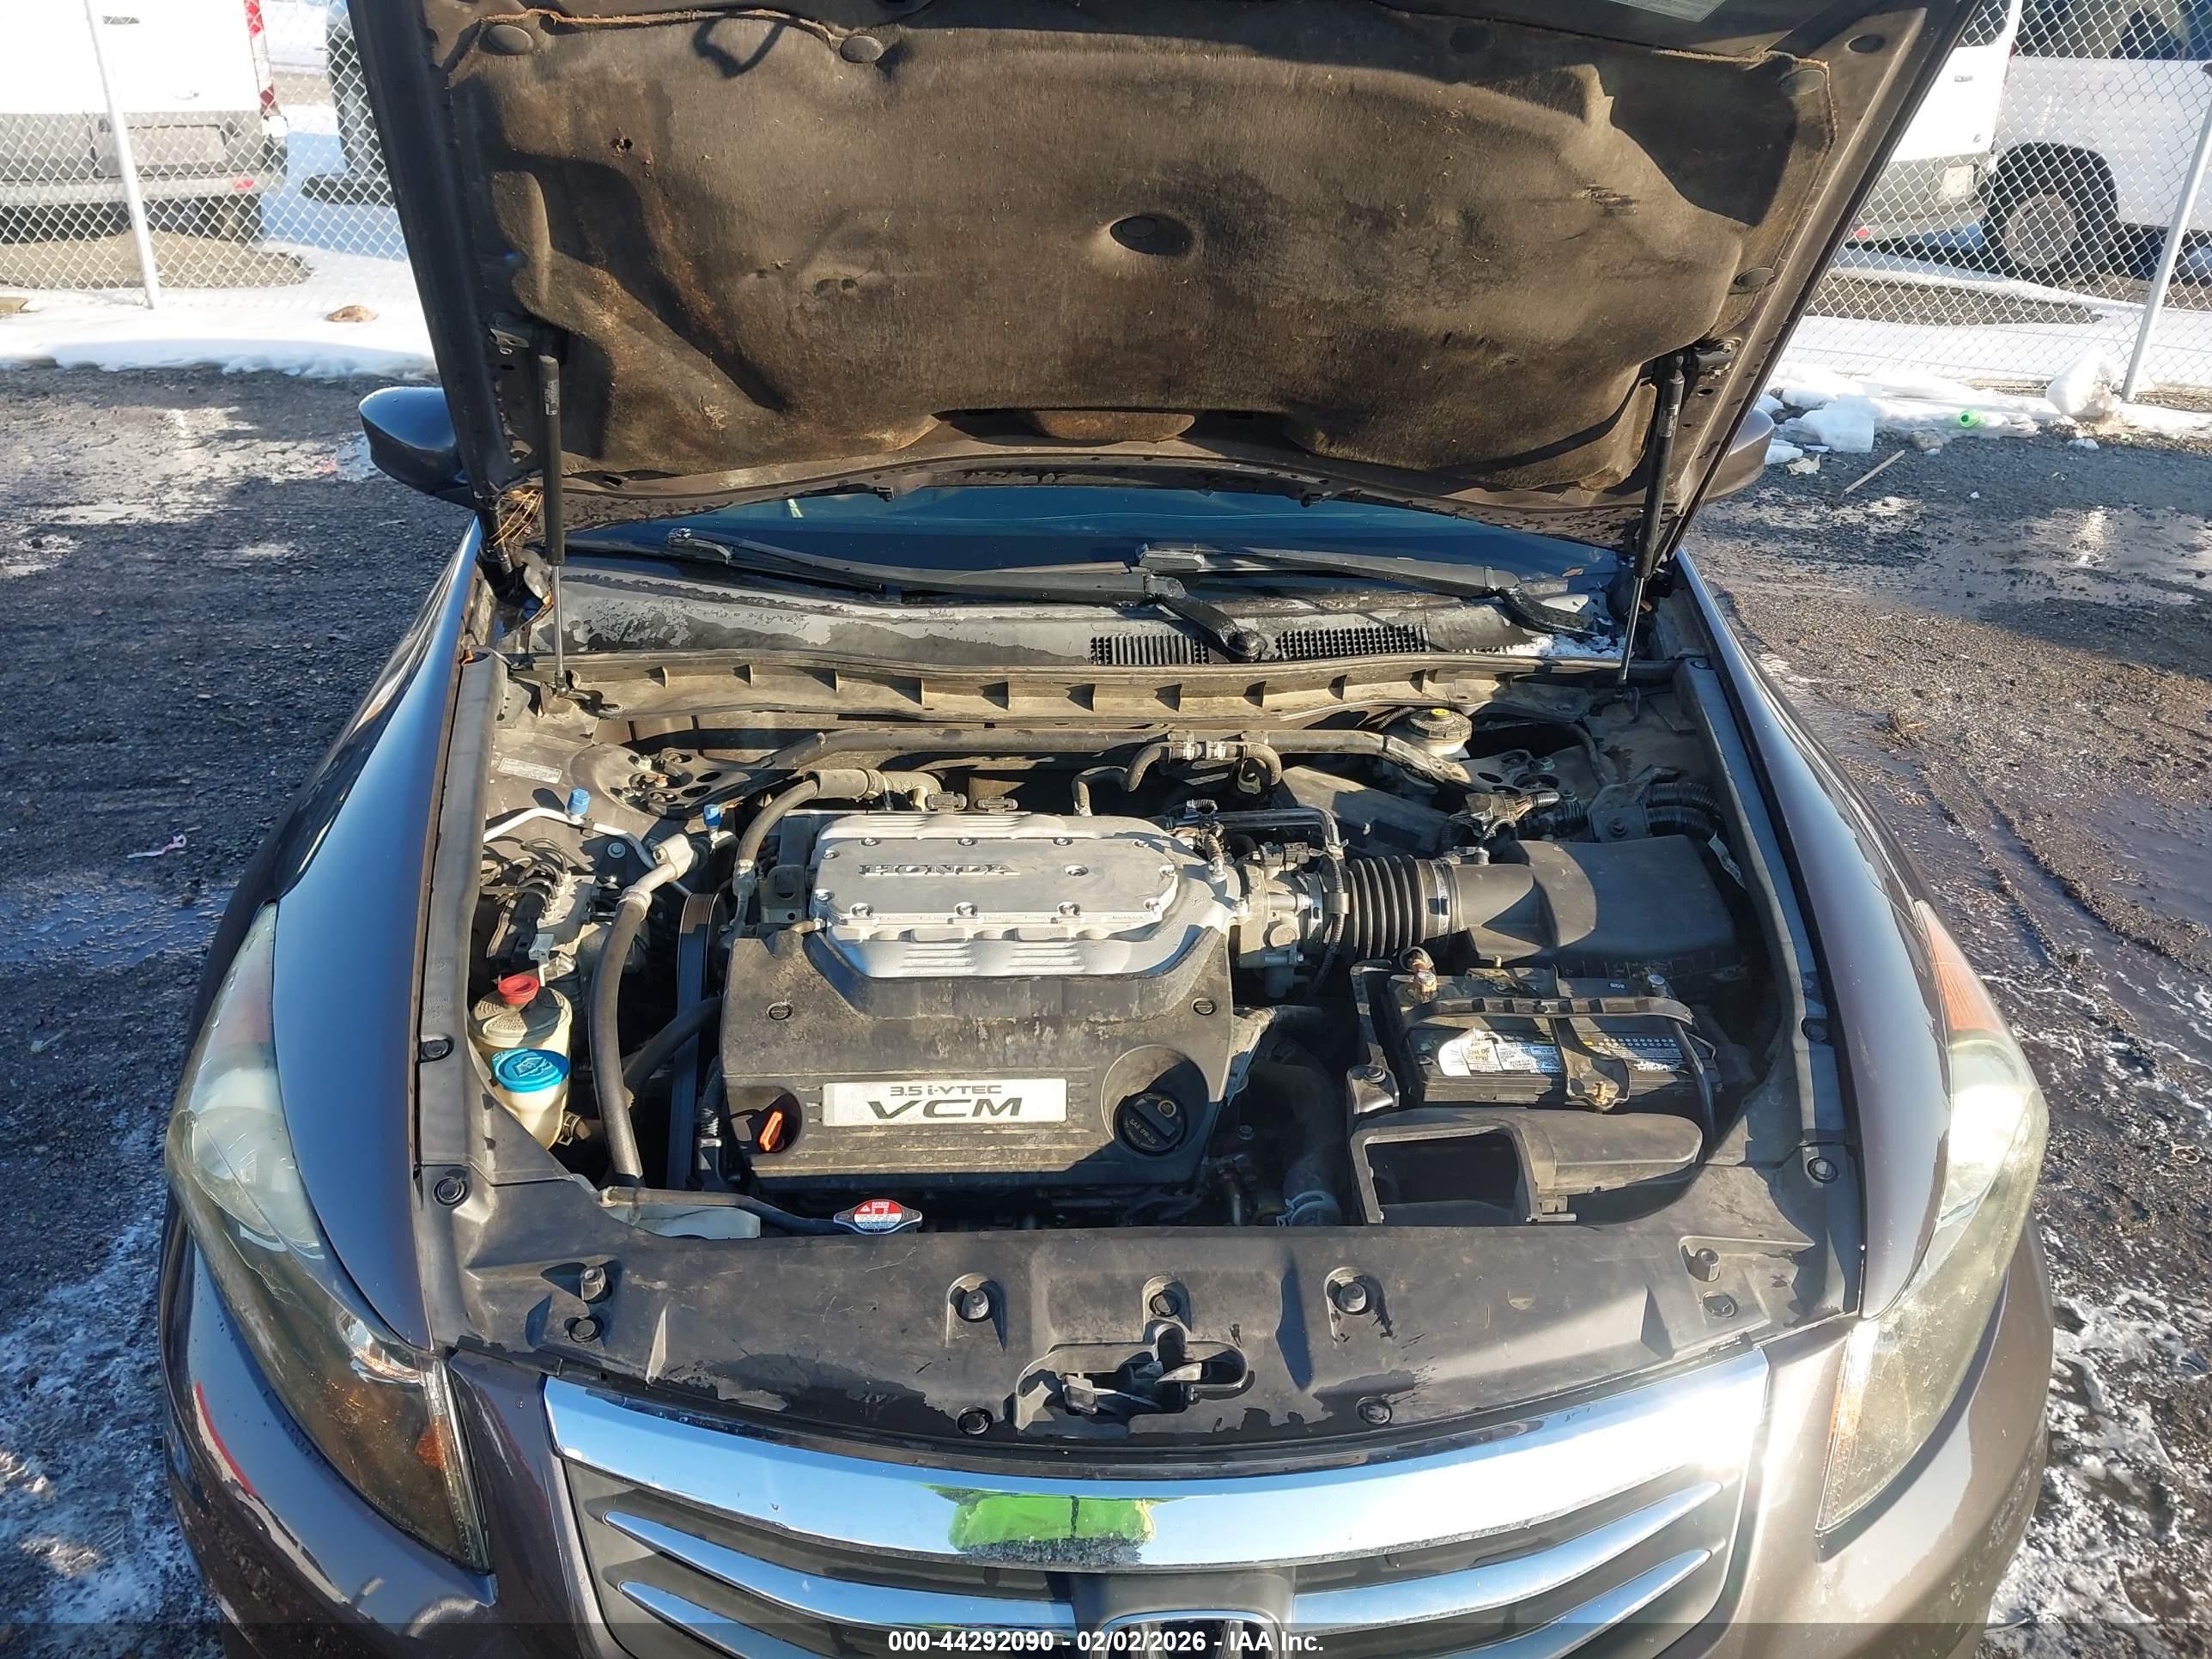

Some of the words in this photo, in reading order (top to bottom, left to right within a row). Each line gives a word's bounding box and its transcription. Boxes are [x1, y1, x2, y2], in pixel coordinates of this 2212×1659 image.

[859, 864, 1020, 877] HONDA
[890, 1085, 922, 1097] 3.5
[927, 1085, 1002, 1096] i-VTEC
[866, 1097, 1023, 1120] VCM
